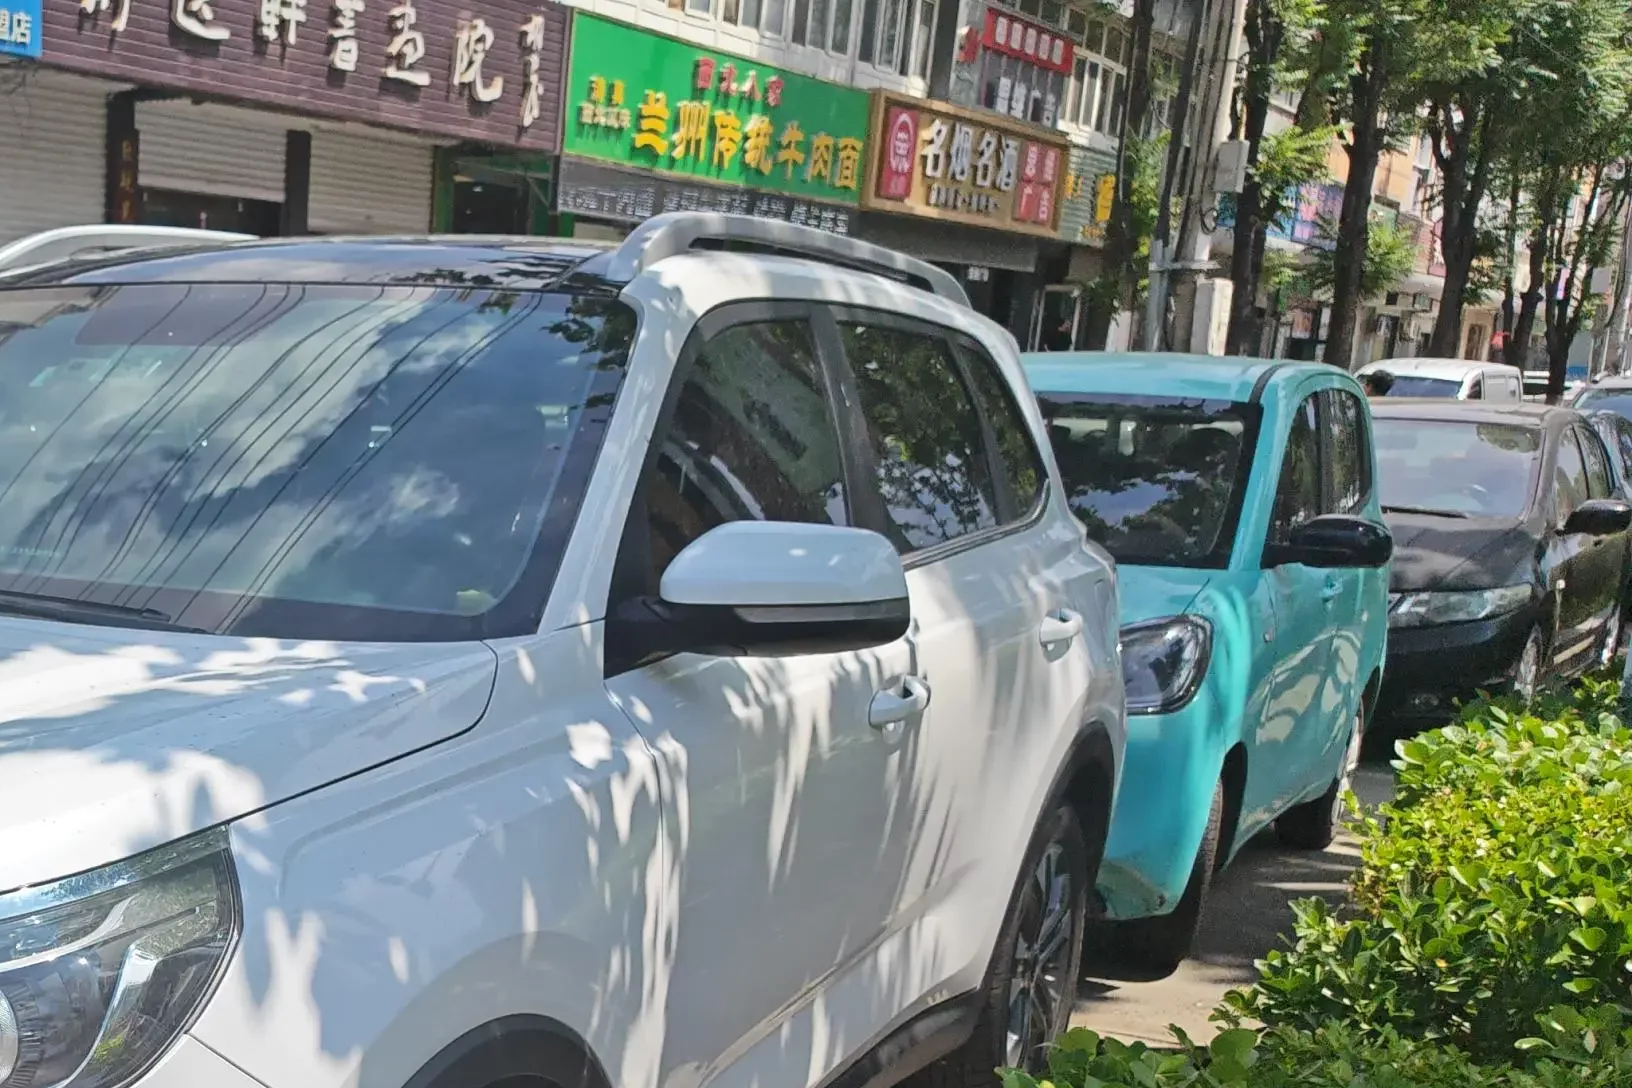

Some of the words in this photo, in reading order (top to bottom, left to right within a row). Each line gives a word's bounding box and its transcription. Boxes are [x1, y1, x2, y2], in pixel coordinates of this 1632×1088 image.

[633, 89, 864, 190] 兰州传统牛肉面
[920, 118, 1018, 191] 名烟名酒
